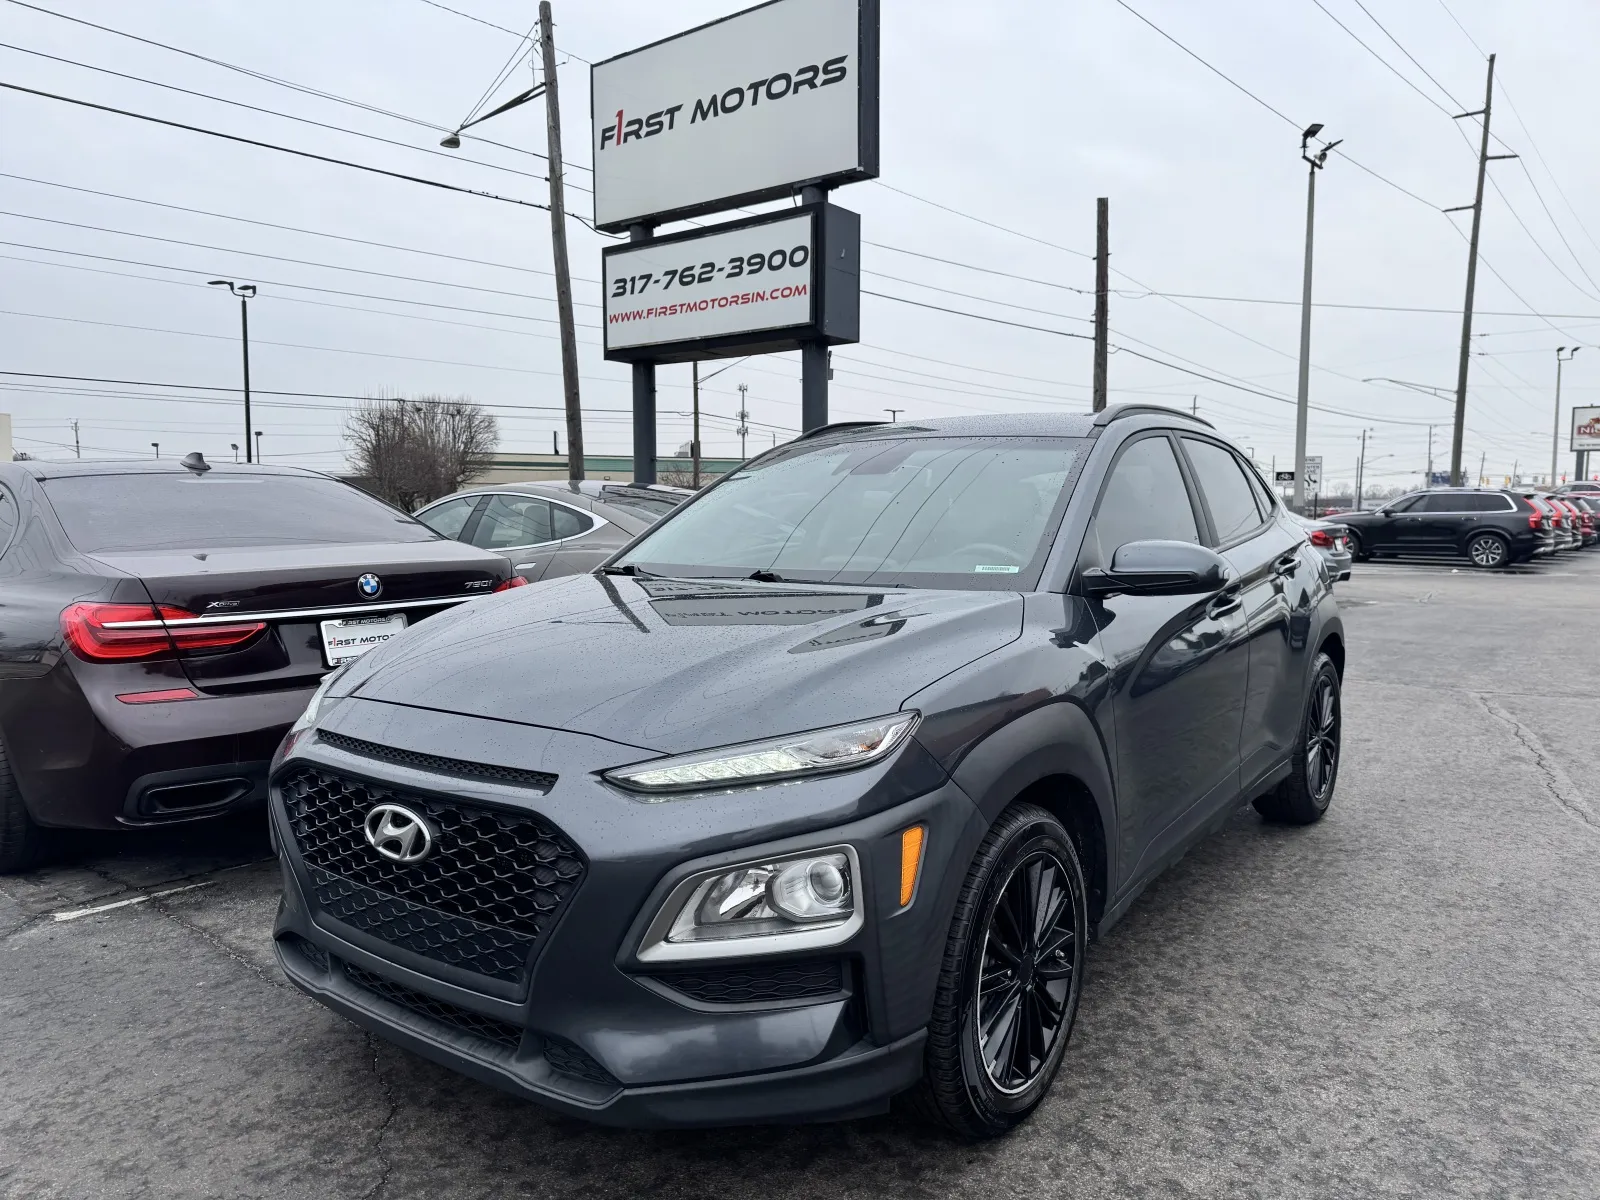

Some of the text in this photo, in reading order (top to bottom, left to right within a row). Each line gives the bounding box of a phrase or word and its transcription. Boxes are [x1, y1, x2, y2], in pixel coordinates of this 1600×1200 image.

[690, 55, 848, 124] MOTORS
[611, 245, 809, 298] 317-762-3900
[609, 284, 807, 324] WWW.FIRSTMOTORSIN.COM
[360, 633, 396, 644] MOTO
